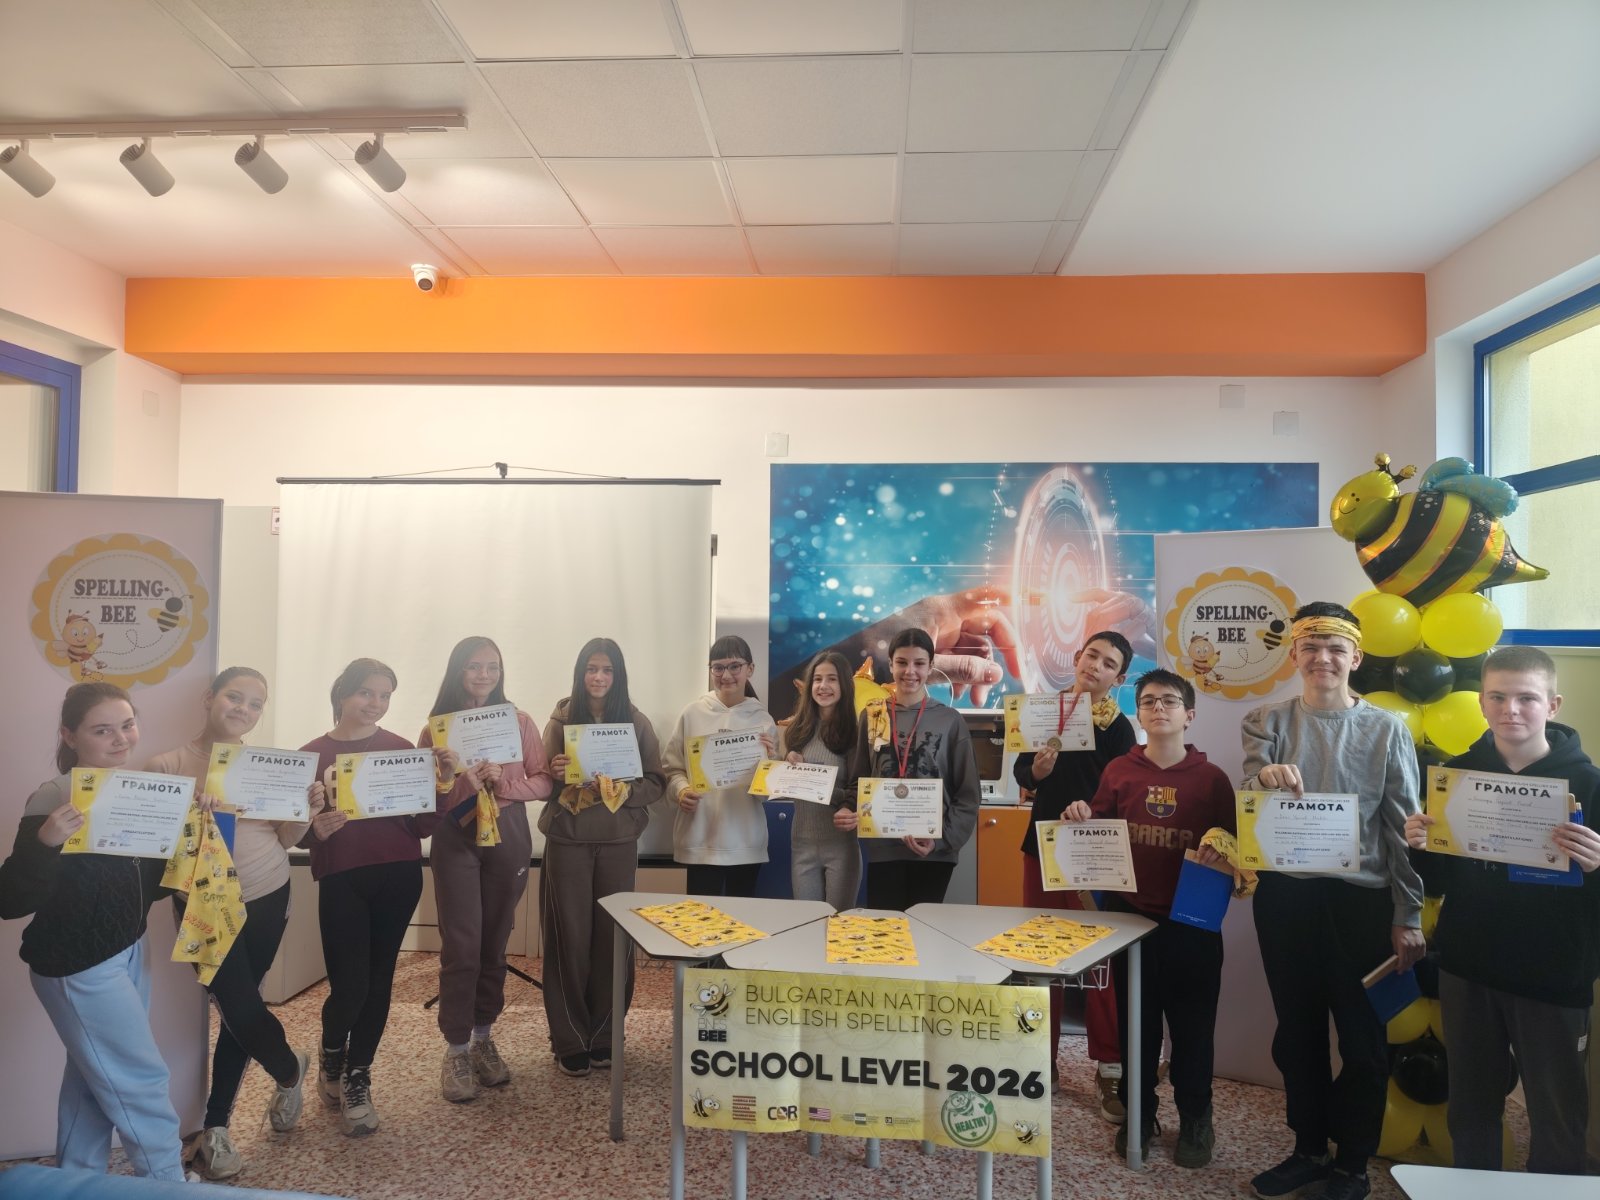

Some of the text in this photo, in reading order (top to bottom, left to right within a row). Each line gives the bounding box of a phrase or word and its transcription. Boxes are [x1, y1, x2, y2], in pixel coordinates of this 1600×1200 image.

[74, 578, 163, 598] SPELLING
[101, 605, 136, 623] BEE
[1196, 605, 1268, 621] SPELLING
[1217, 627, 1246, 642] BEE
[462, 712, 508, 723] ГРАМОТА
[714, 735, 756, 746] ГРАМОТА
[251, 756, 306, 767] ГРАМОТА
[374, 756, 425, 766] ГРАМОТА
[121, 780, 181, 794] ГРАМОТА
[1476, 783, 1551, 798] ГРАМОТА
[1280, 802, 1344, 811] ГРАМОТА
[746, 985, 1000, 1018] BULGARIAN NATIONAL
[746, 1007, 1000, 1040] ENGLISH SPELLING BEE
[698, 1030, 727, 1042] BEE
[690, 1049, 1045, 1099] SCHOOL LEVEL 2026
[955, 1116, 987, 1133] HEALTHY
